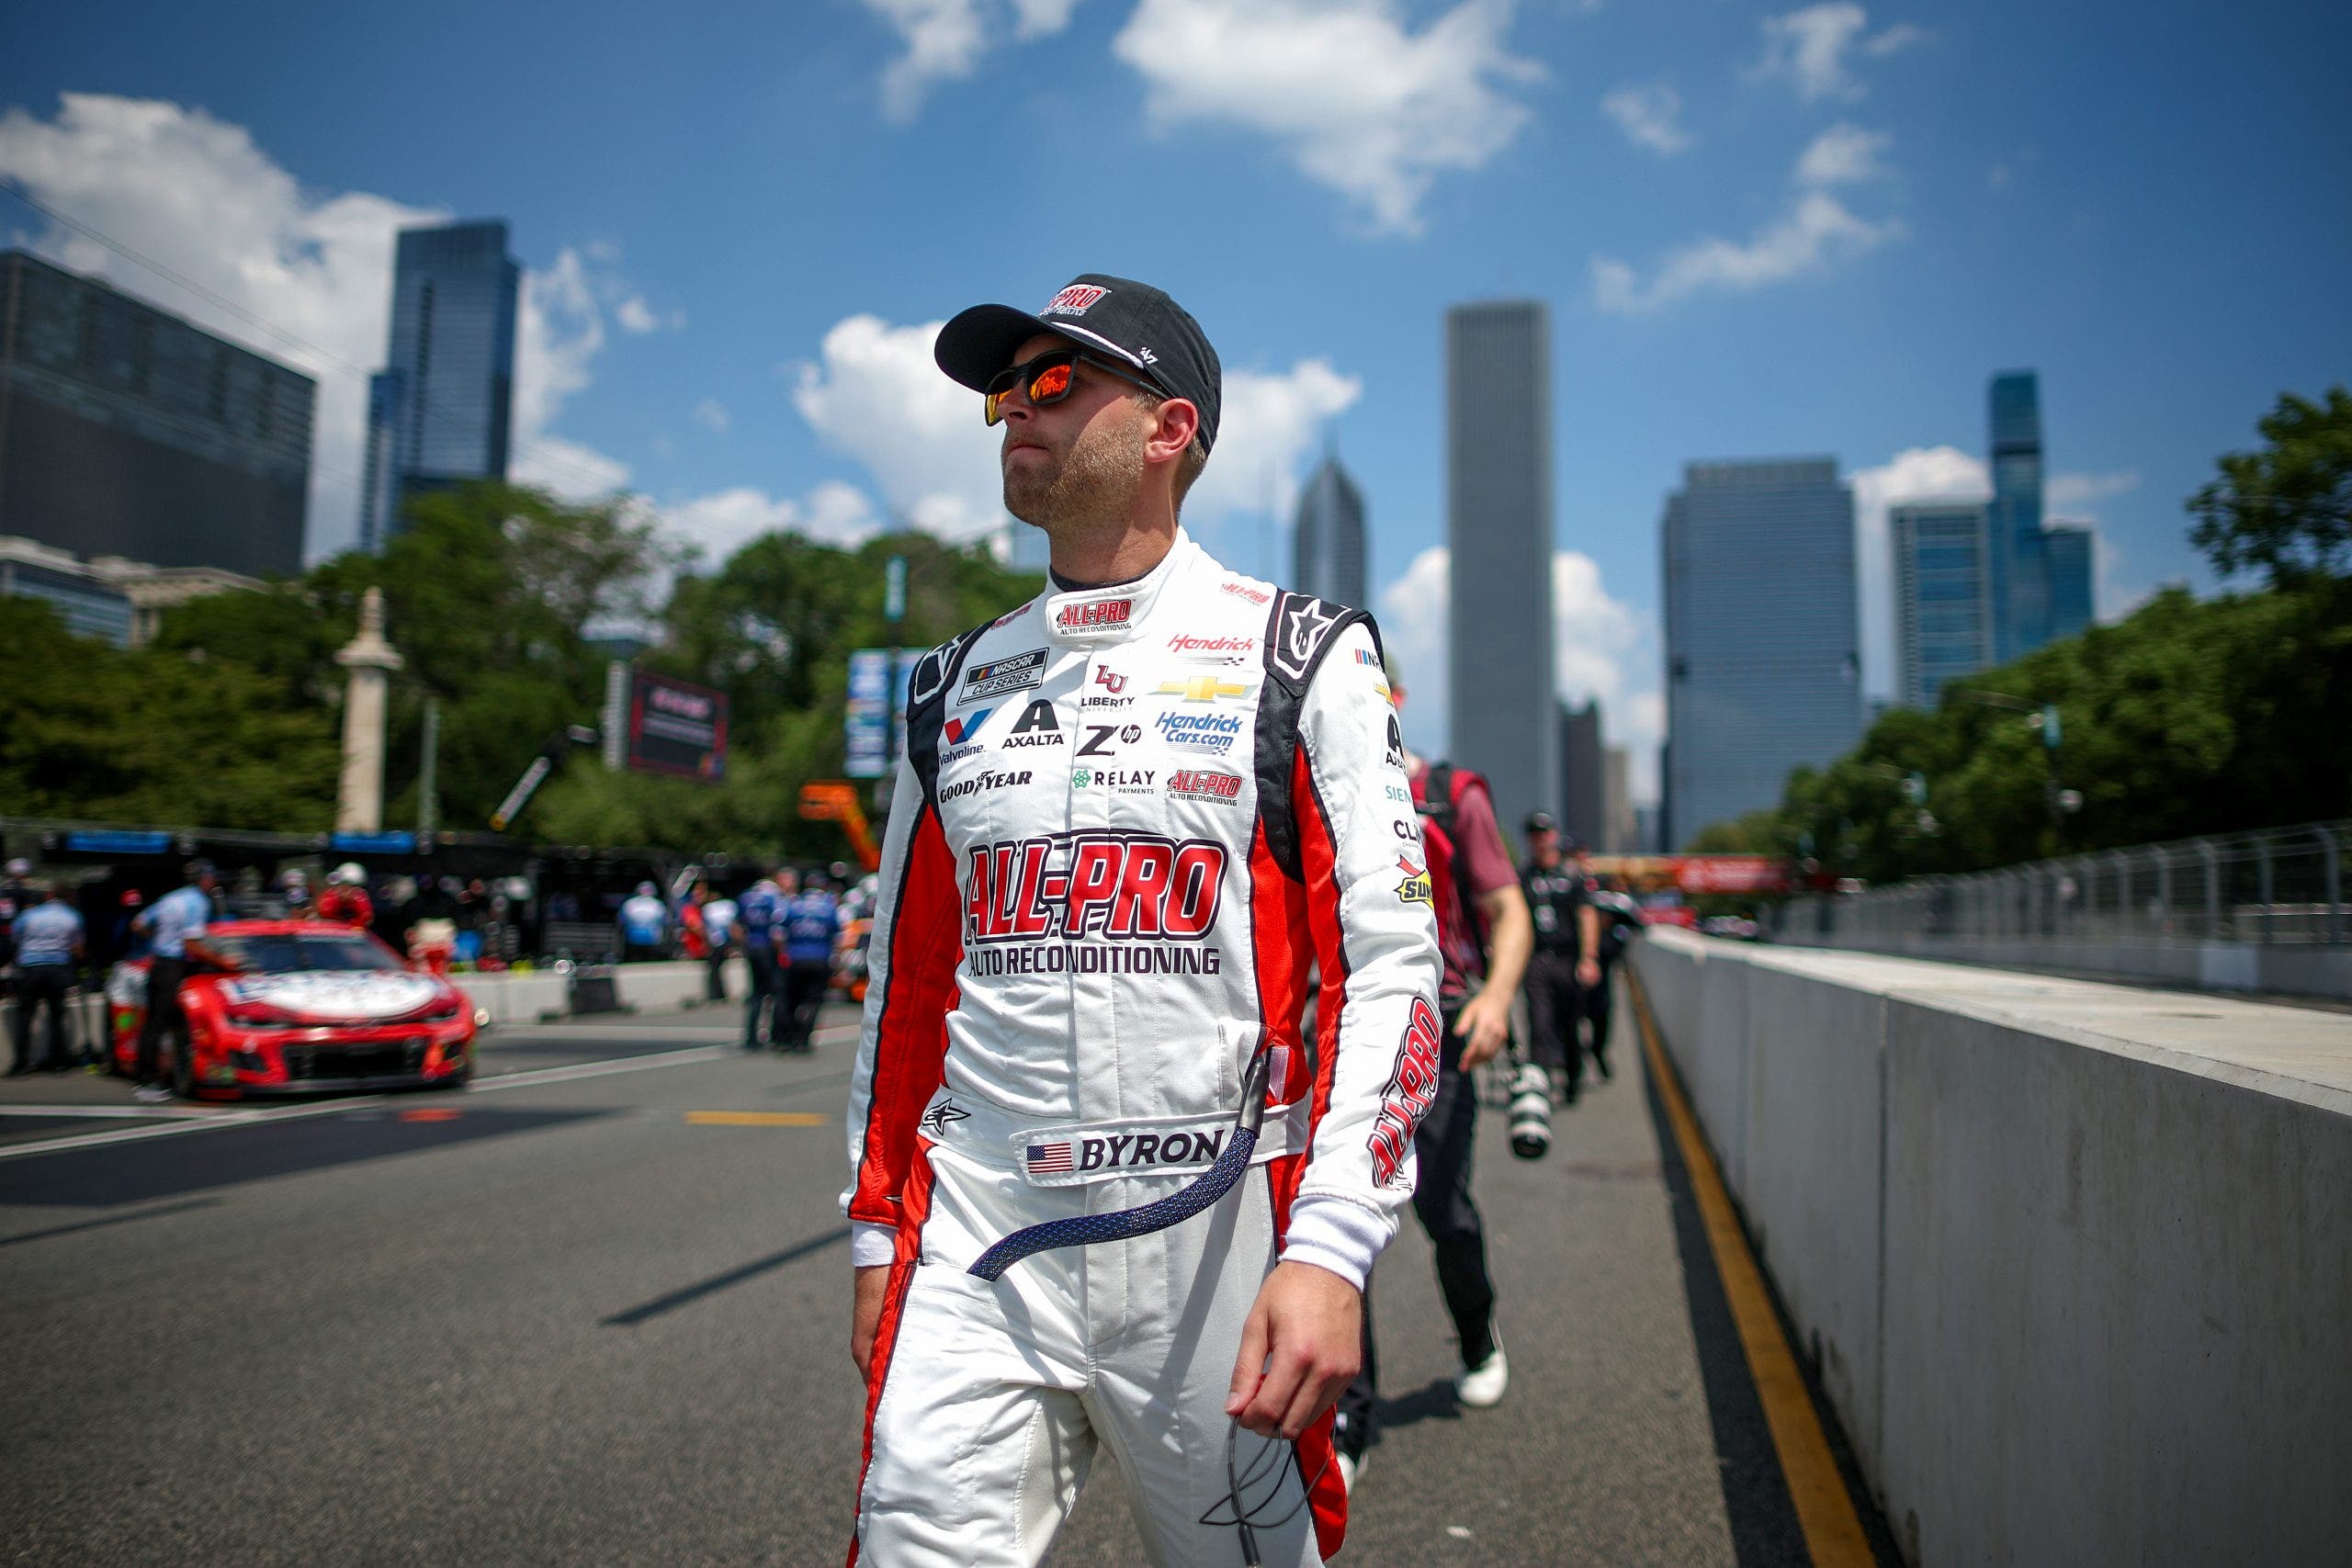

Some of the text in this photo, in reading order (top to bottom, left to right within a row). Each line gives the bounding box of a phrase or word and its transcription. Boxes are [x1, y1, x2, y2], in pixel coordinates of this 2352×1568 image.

[1057, 599, 1132, 628] ALL-PRO
[1060, 623, 1132, 636] AUTO RECONDITIONING
[1167, 633, 1256, 653] Hendrick
[991, 654, 1035, 676] NASCAR
[972, 671, 1033, 695] CUP SERIES
[1080, 696, 1136, 707] LIBERTY
[1155, 711, 1243, 734] Hendrick
[1001, 734, 1064, 749] AXALTA
[1121, 724, 1141, 744] hp
[1166, 728, 1234, 747] Cars.com
[939, 744, 985, 766] Valvoline
[940, 770, 1033, 804] GOODYEAR
[1094, 770, 1156, 786] RELAY
[1167, 770, 1243, 798] ALL-PRO
[1186, 794, 1238, 807] RECONDITIONING
[965, 834, 1229, 946] ALL-PRO
[1404, 880, 1431, 900] SUN
[968, 947, 1221, 977] AUTO RECONDITIONING
[1366, 997, 1441, 1190] ALL-PRO
[1079, 1129, 1225, 1171] BYRON
